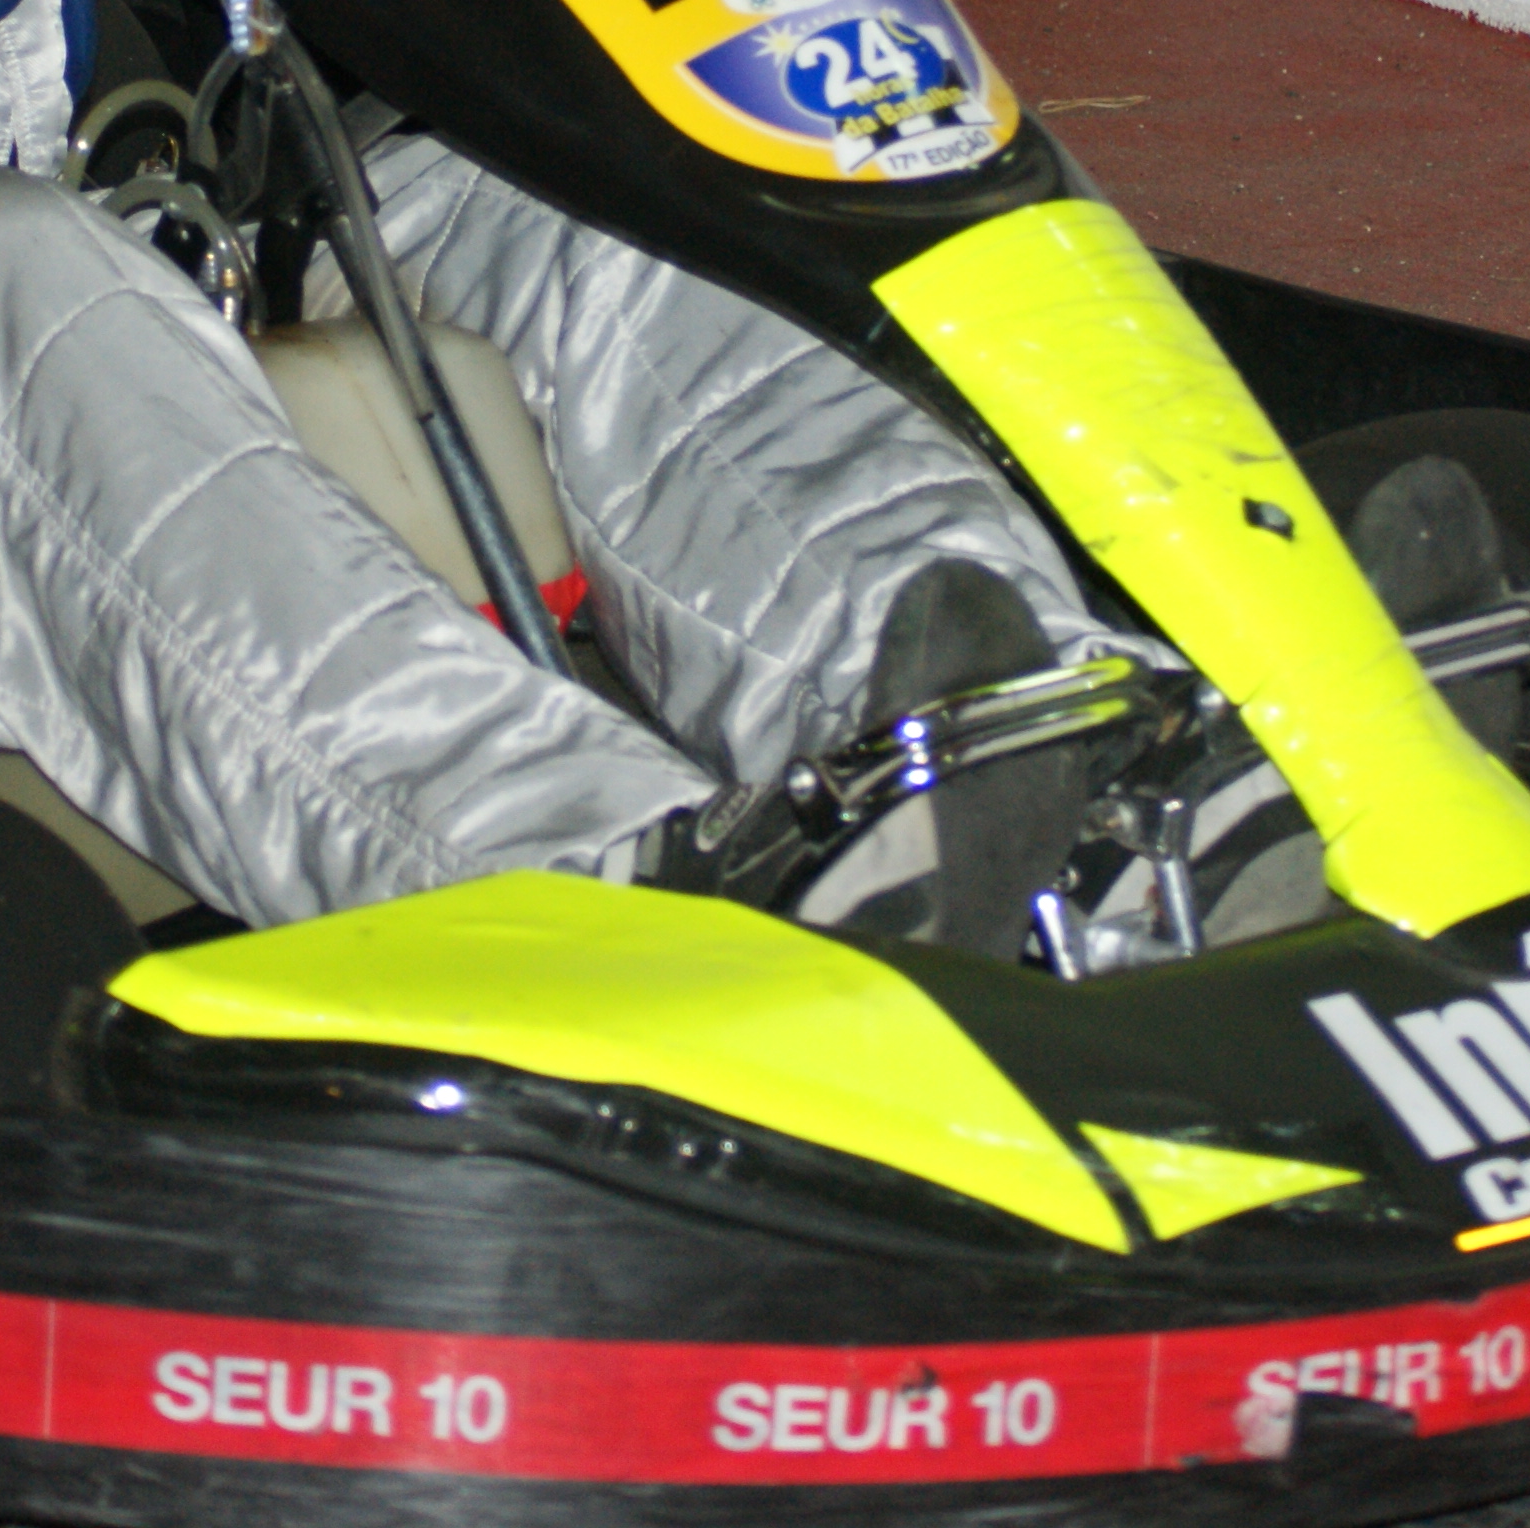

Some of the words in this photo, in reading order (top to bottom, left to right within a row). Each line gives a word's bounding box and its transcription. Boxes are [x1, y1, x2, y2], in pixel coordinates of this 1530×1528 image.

[795, 19, 919, 109] 24
[874, 85, 967, 126] Batalha
[924, 129, 990, 167] EDIÇÃO
[152, 1351, 393, 1436] SEUR
[420, 1375, 508, 1444] 10
[711, 1382, 948, 1453] SEUR
[971, 1377, 1055, 1447] 10
[1459, 1324, 1526, 1394] 10
